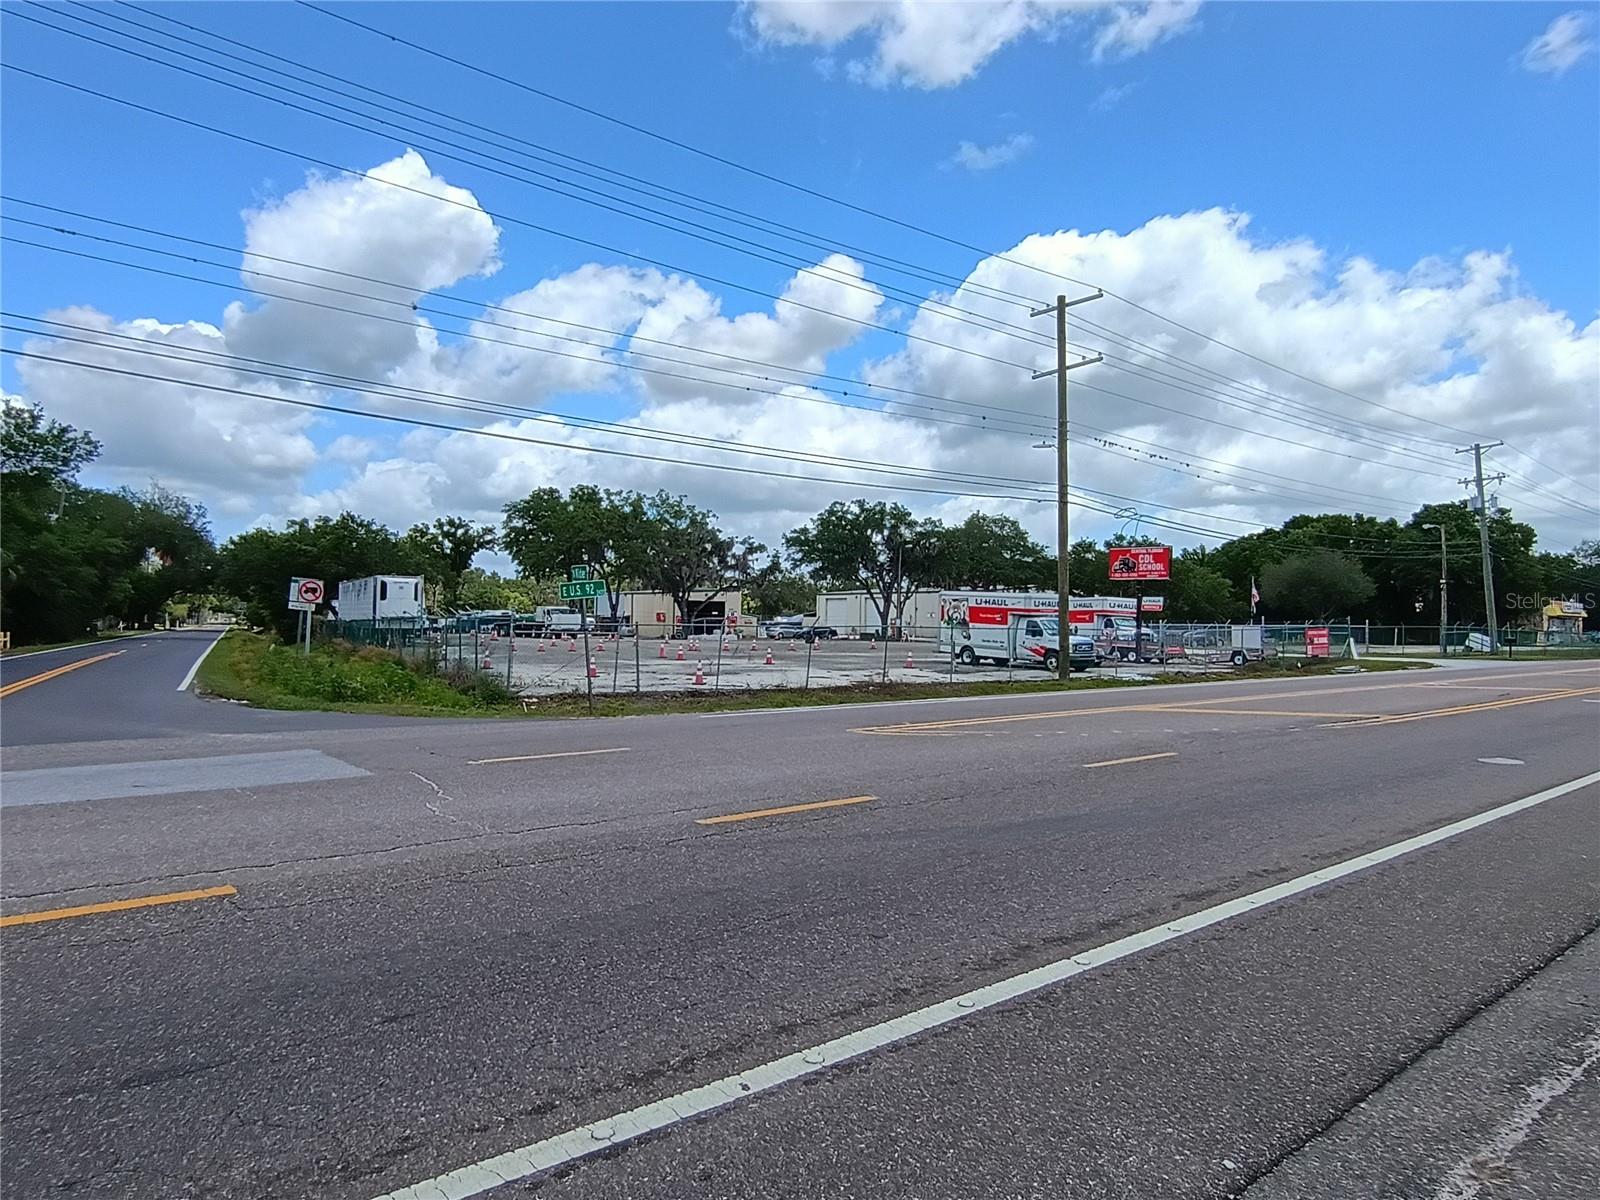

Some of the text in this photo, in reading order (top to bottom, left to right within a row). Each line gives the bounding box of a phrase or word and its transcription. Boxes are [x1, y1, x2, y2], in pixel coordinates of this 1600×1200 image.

[1138, 554, 1154, 563] CDL
[562, 586, 568, 596] E
[585, 584, 594, 594] 92
[975, 598, 1008, 606] U-HAUL
